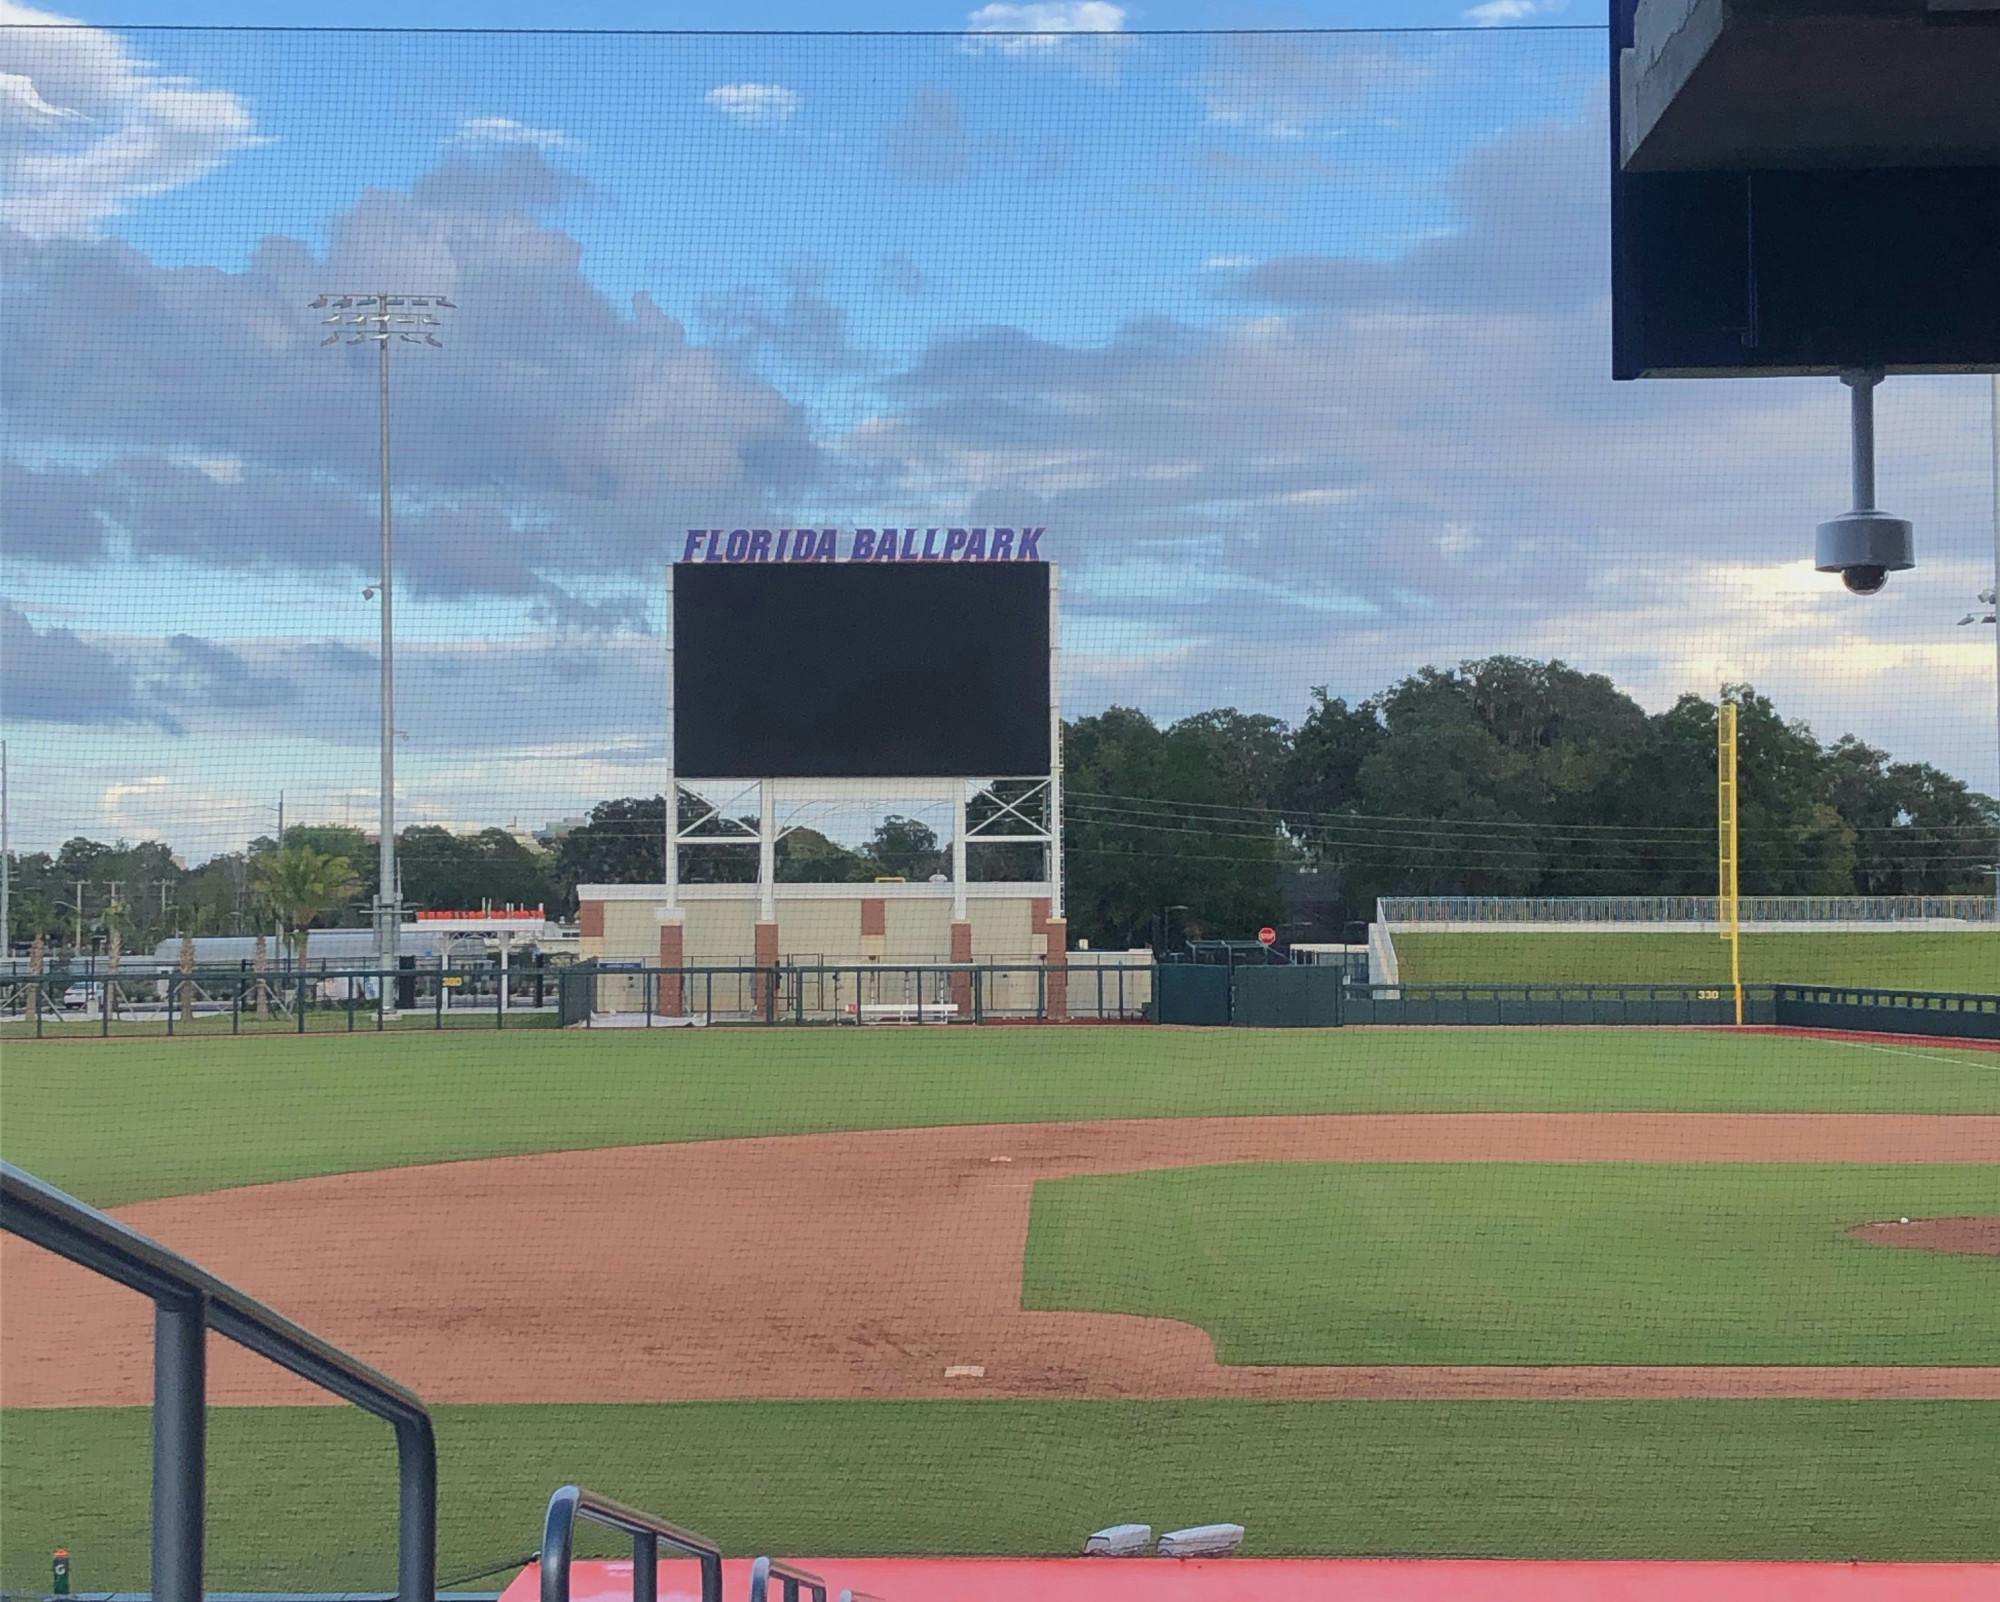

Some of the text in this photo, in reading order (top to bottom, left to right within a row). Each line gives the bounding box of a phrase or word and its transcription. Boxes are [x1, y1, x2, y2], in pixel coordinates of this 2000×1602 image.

[682, 527, 1046, 562] FLORIDA BALLPARK
[1697, 990, 1719, 1000] 330
[55, 1564, 66, 1575] G
